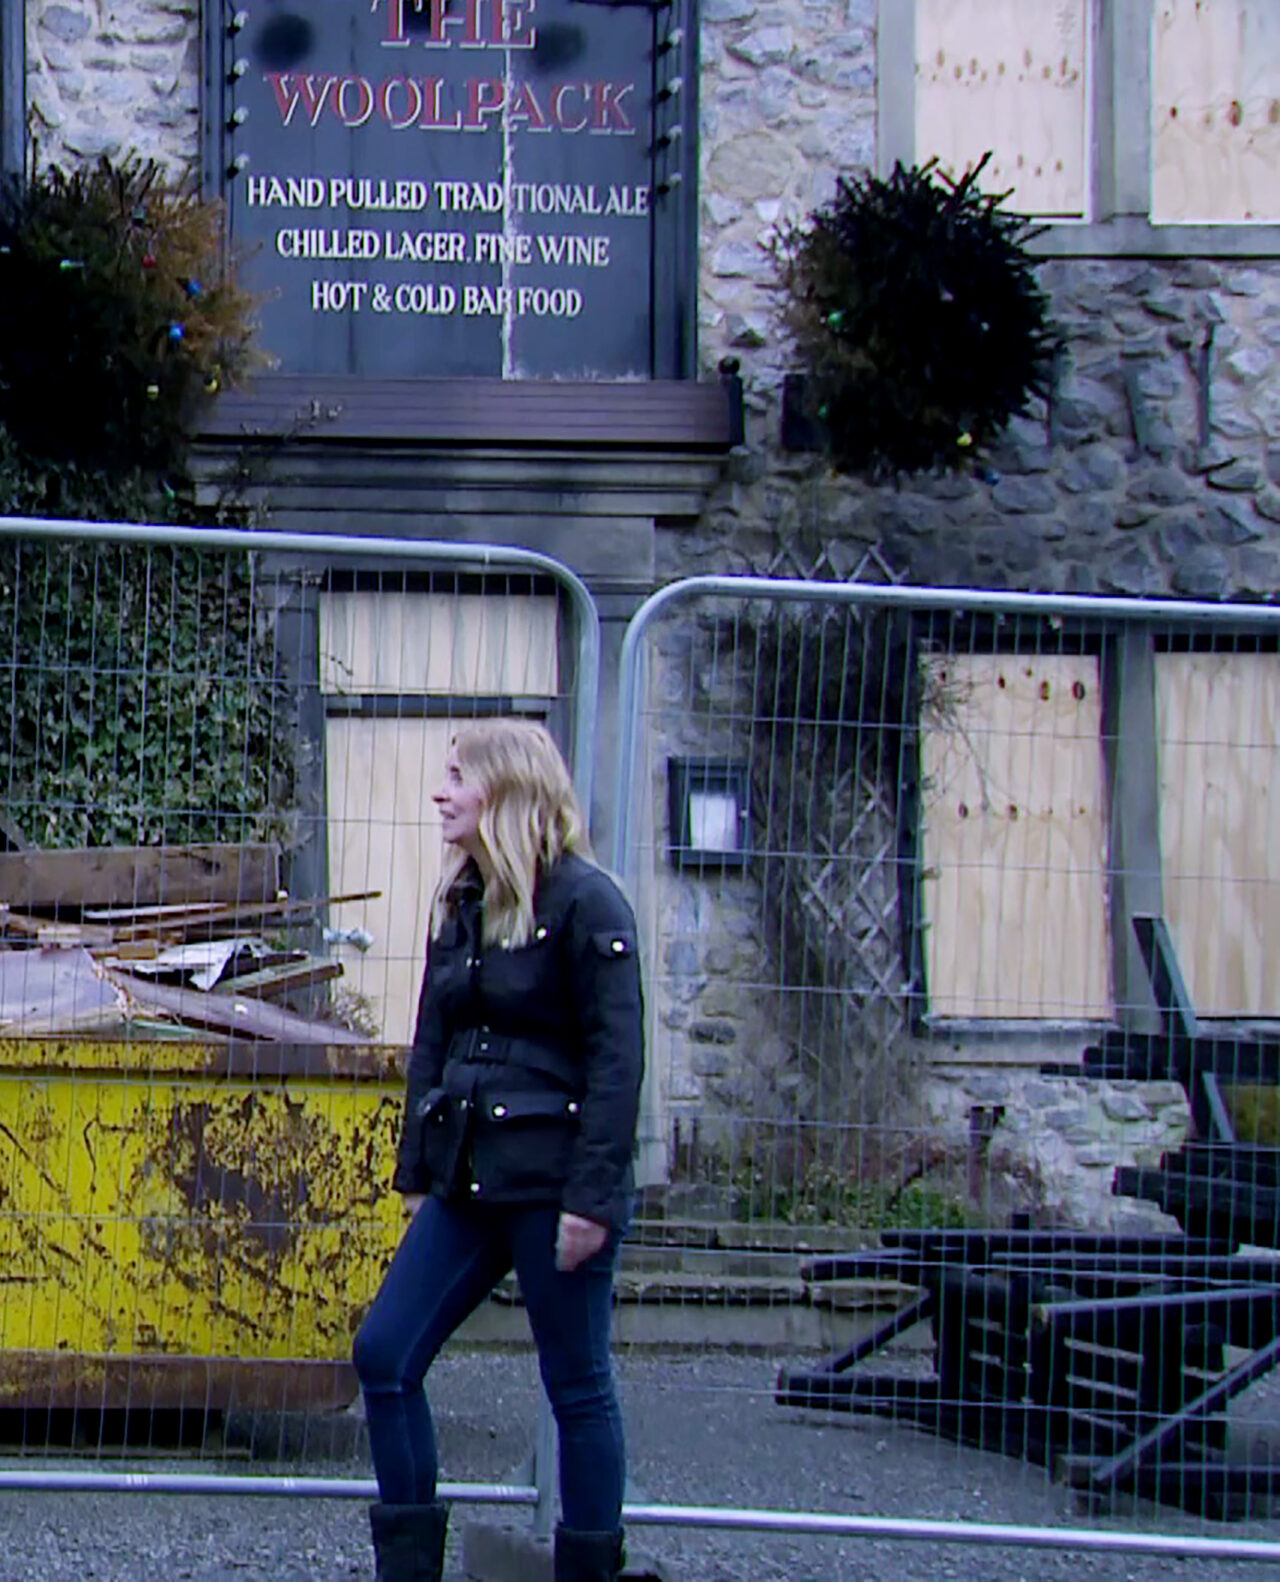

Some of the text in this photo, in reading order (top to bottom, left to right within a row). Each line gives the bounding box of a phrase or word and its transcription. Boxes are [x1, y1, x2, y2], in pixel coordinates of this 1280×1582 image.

[370, 0, 537, 49] THE
[263, 70, 637, 136] WOOLPACK
[247, 175, 651, 217] HAND PULLED TRADTIONAL ALE
[276, 227, 381, 259] CHILLED
[475, 232, 533, 264] FINE
[536, 235, 611, 267] WINE
[311, 279, 368, 312] HOT
[371, 282, 392, 313] &
[394, 282, 457, 315] COLD
[517, 285, 584, 318] FOOD
